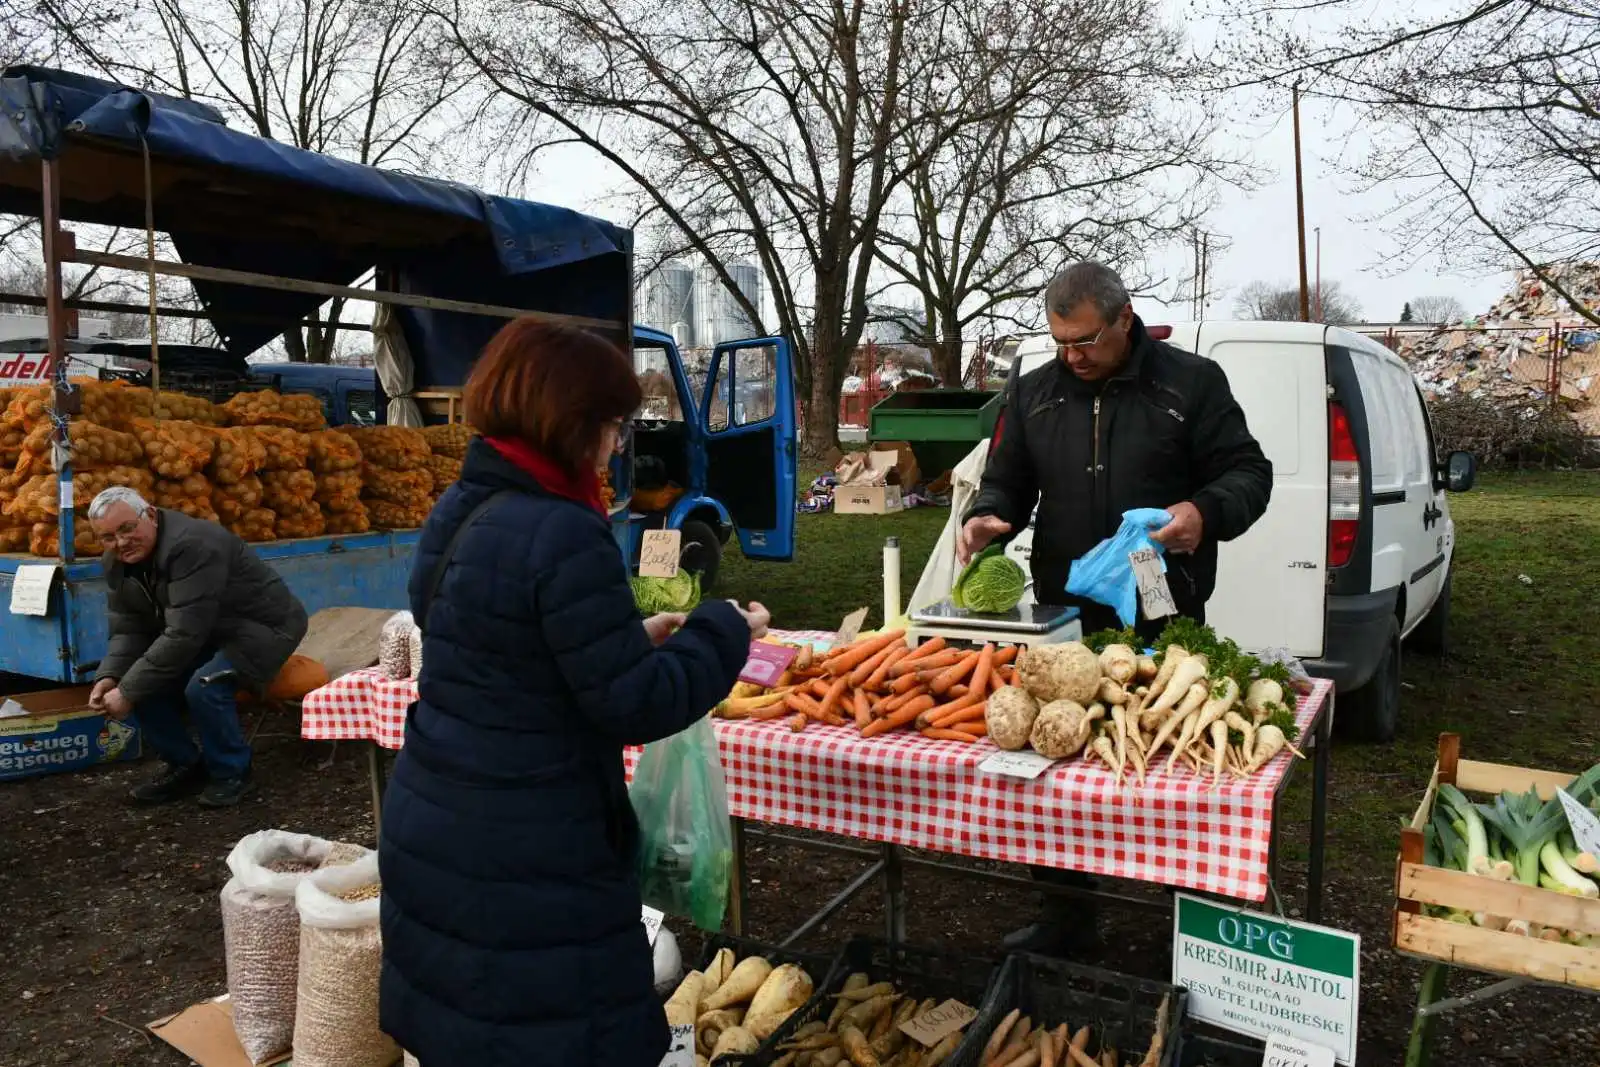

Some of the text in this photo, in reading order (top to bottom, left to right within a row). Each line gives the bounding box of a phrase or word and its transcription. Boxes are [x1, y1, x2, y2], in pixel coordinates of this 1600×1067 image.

[1218, 916, 1295, 960] OPG
[1180, 977, 1246, 1006] SESVETE
[1184, 941, 1346, 1000] KREŠIMIR JANTOL
